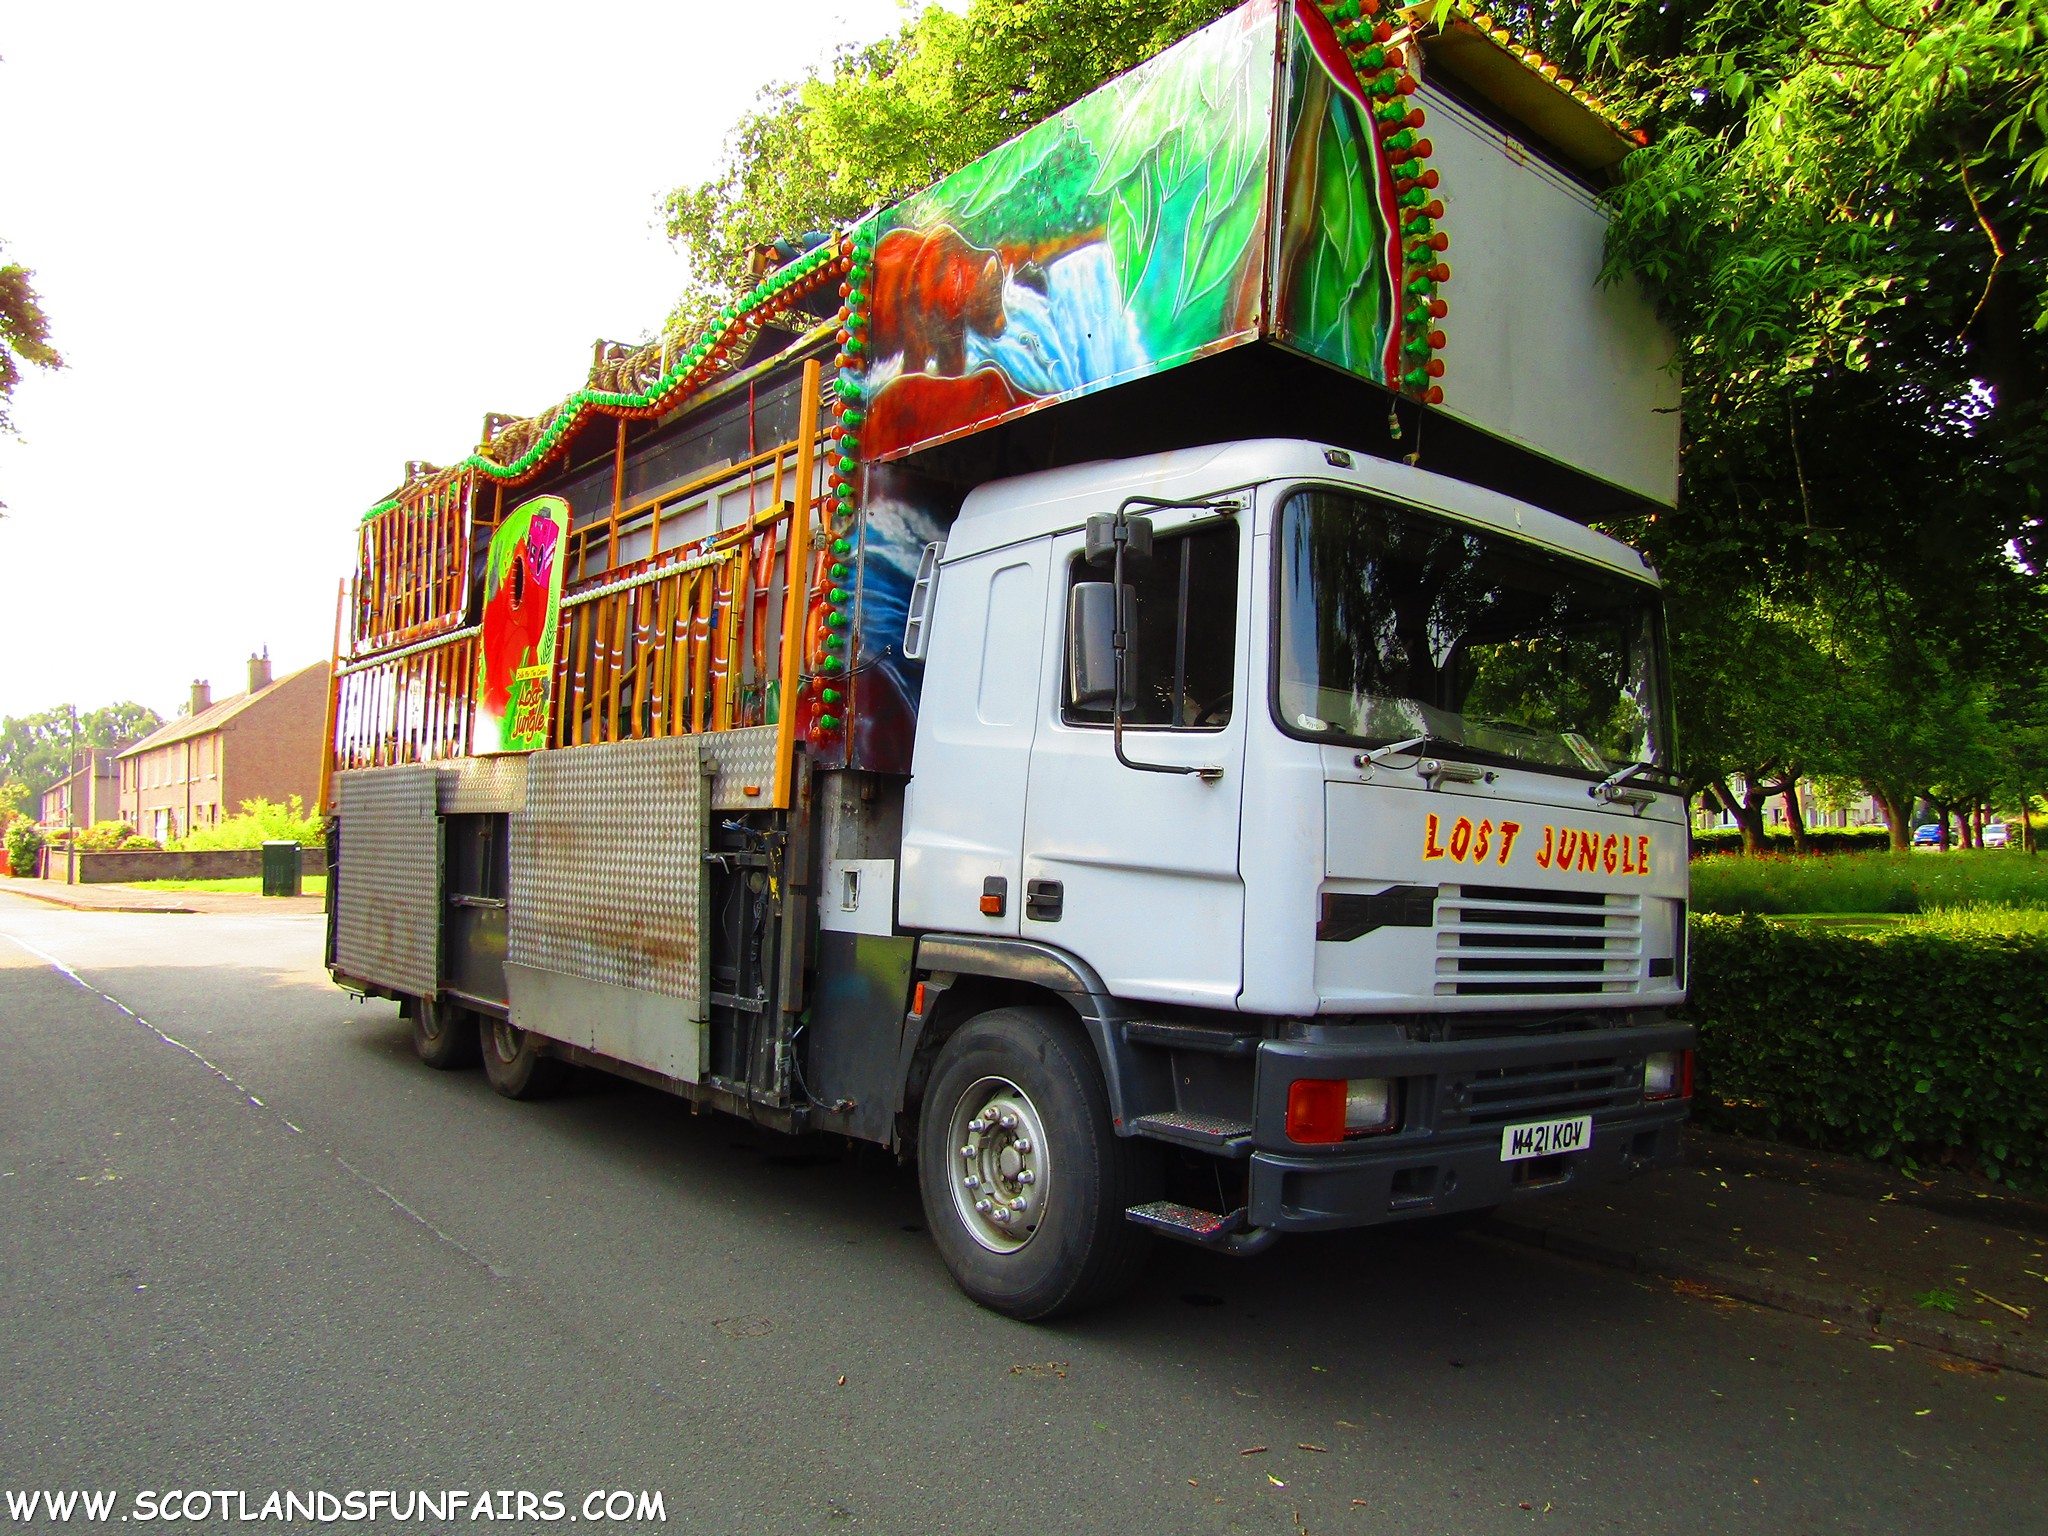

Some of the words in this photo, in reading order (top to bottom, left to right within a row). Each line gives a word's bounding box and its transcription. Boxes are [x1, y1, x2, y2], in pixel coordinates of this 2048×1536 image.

[518, 684, 543, 708] Lost
[511, 709, 545, 742] Jungle
[1423, 813, 1520, 866] LOST
[1536, 825, 1650, 876] JUNGLE
[1511, 1126, 1550, 1155] M421
[1552, 1121, 1583, 1149] KOV
